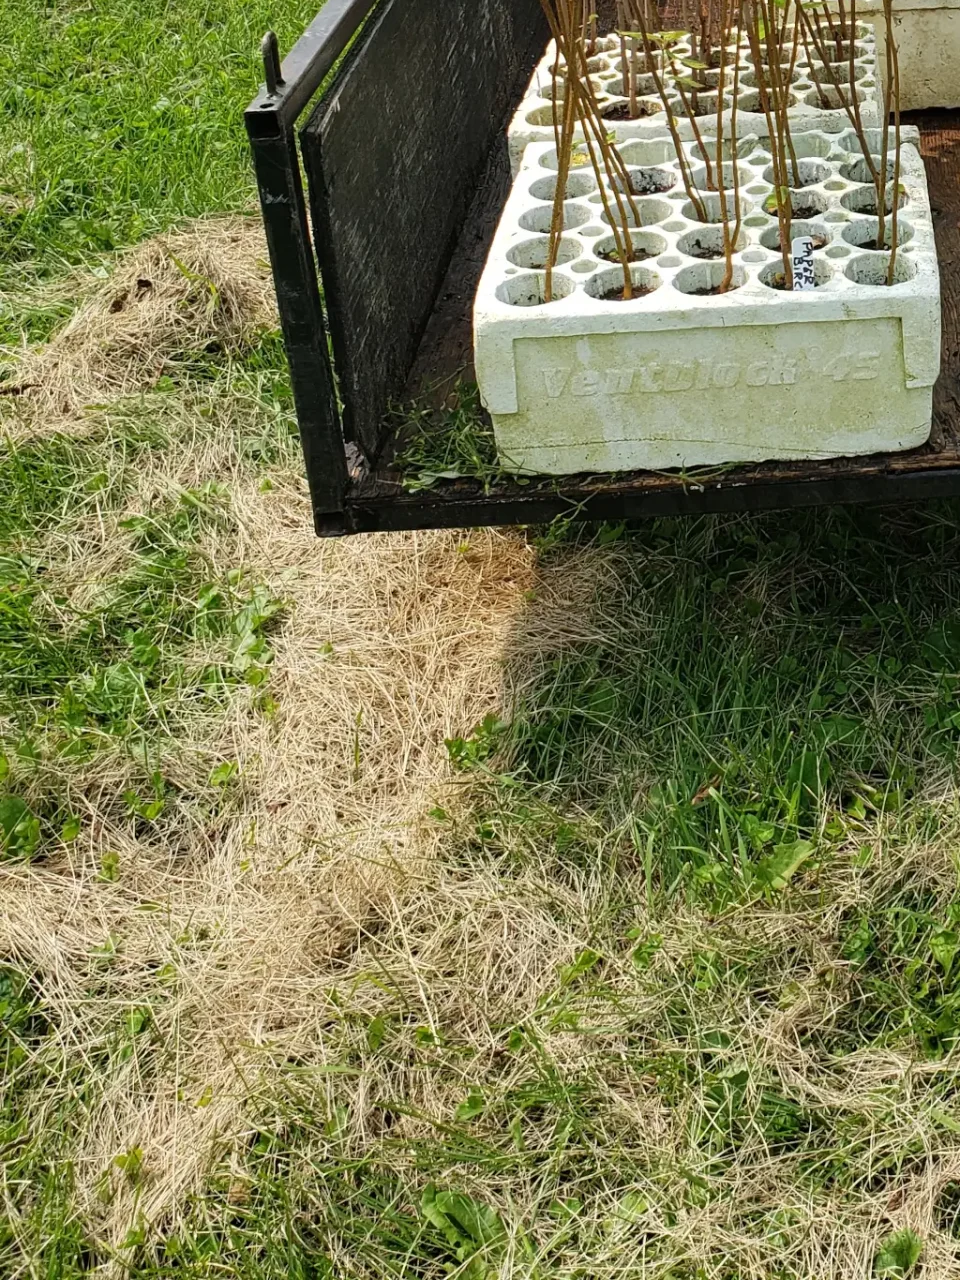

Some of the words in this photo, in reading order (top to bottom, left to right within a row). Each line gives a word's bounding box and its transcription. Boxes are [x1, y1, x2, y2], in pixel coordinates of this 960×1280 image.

[794, 257, 803, 290] BIRC
[802, 242, 814, 284] PAPER
[822, 350, 882, 382] 45
